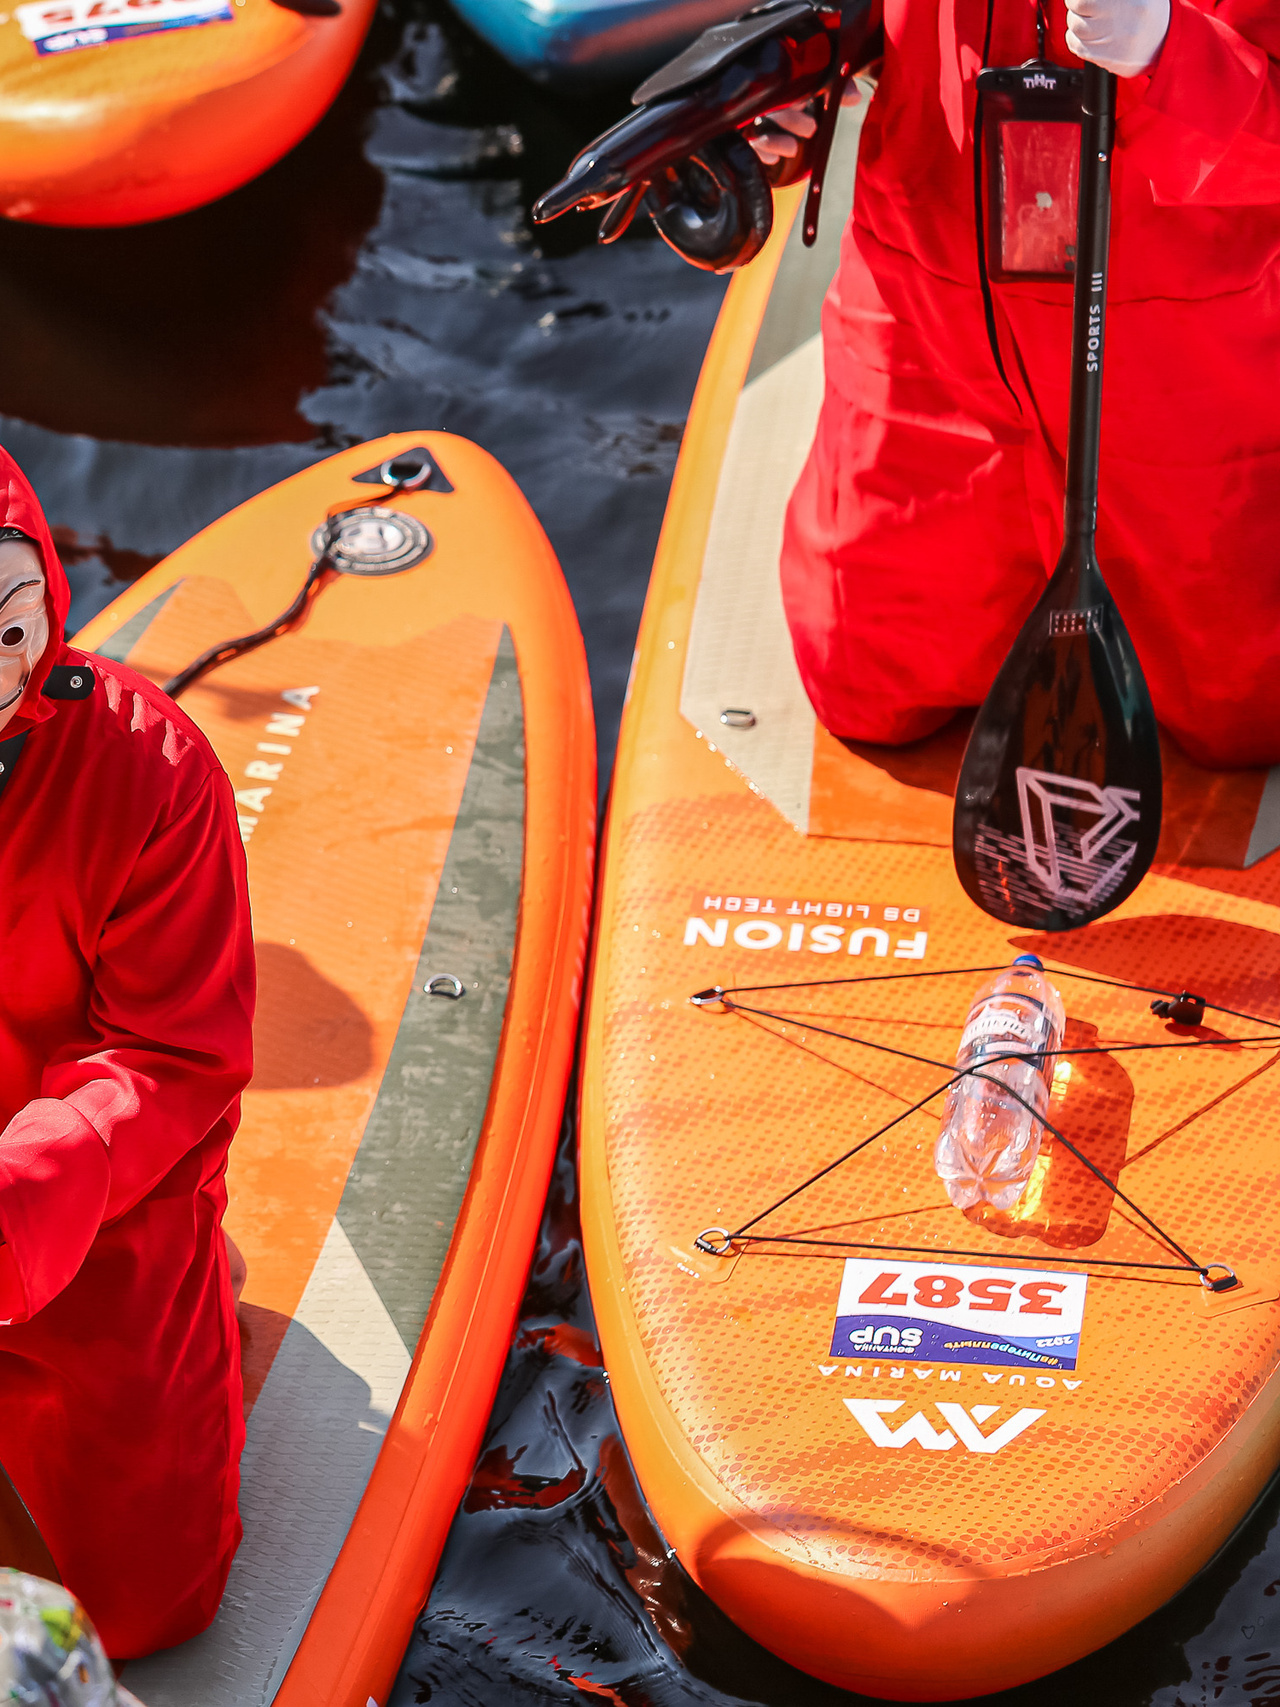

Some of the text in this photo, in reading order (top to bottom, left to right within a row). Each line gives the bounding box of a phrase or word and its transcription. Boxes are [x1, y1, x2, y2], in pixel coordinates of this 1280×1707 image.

[1086, 303, 1101, 373] SPORTS
[703, 895, 777, 914] TECH
[786, 900, 870, 920] LIGHT
[682, 917, 928, 960] FUSION
[857, 1272, 1068, 1316] 3587
[848, 1325, 924, 1347] SUP
[1035, 1335, 1074, 1349] 2022
[817, 1364, 1083, 1391] AQUA MARINA
